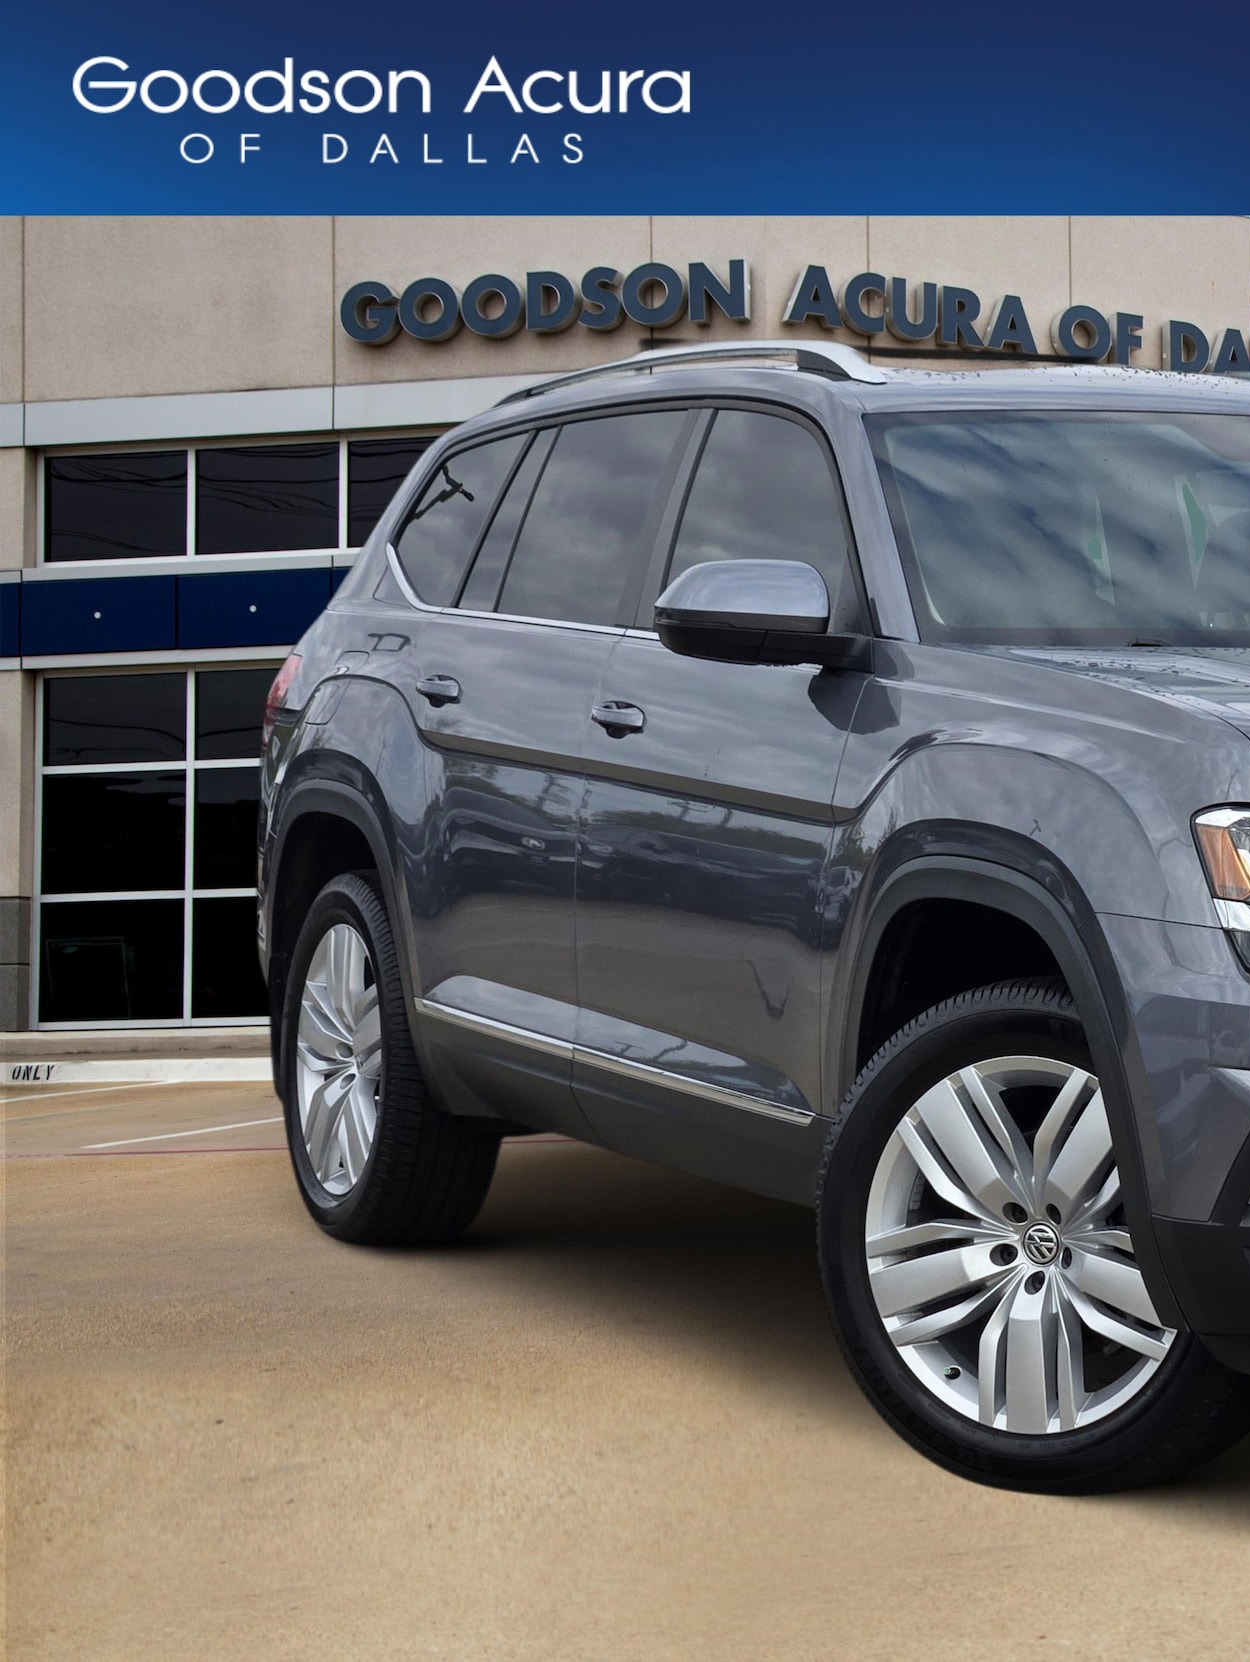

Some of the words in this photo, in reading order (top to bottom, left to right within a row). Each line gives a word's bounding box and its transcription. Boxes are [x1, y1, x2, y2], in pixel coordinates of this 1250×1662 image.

[341, 258, 752, 345] GOODSON
[785, 263, 1036, 355] ACURA
[1054, 304, 1143, 364] OF
[11, 1064, 55, 1081] ONLY
